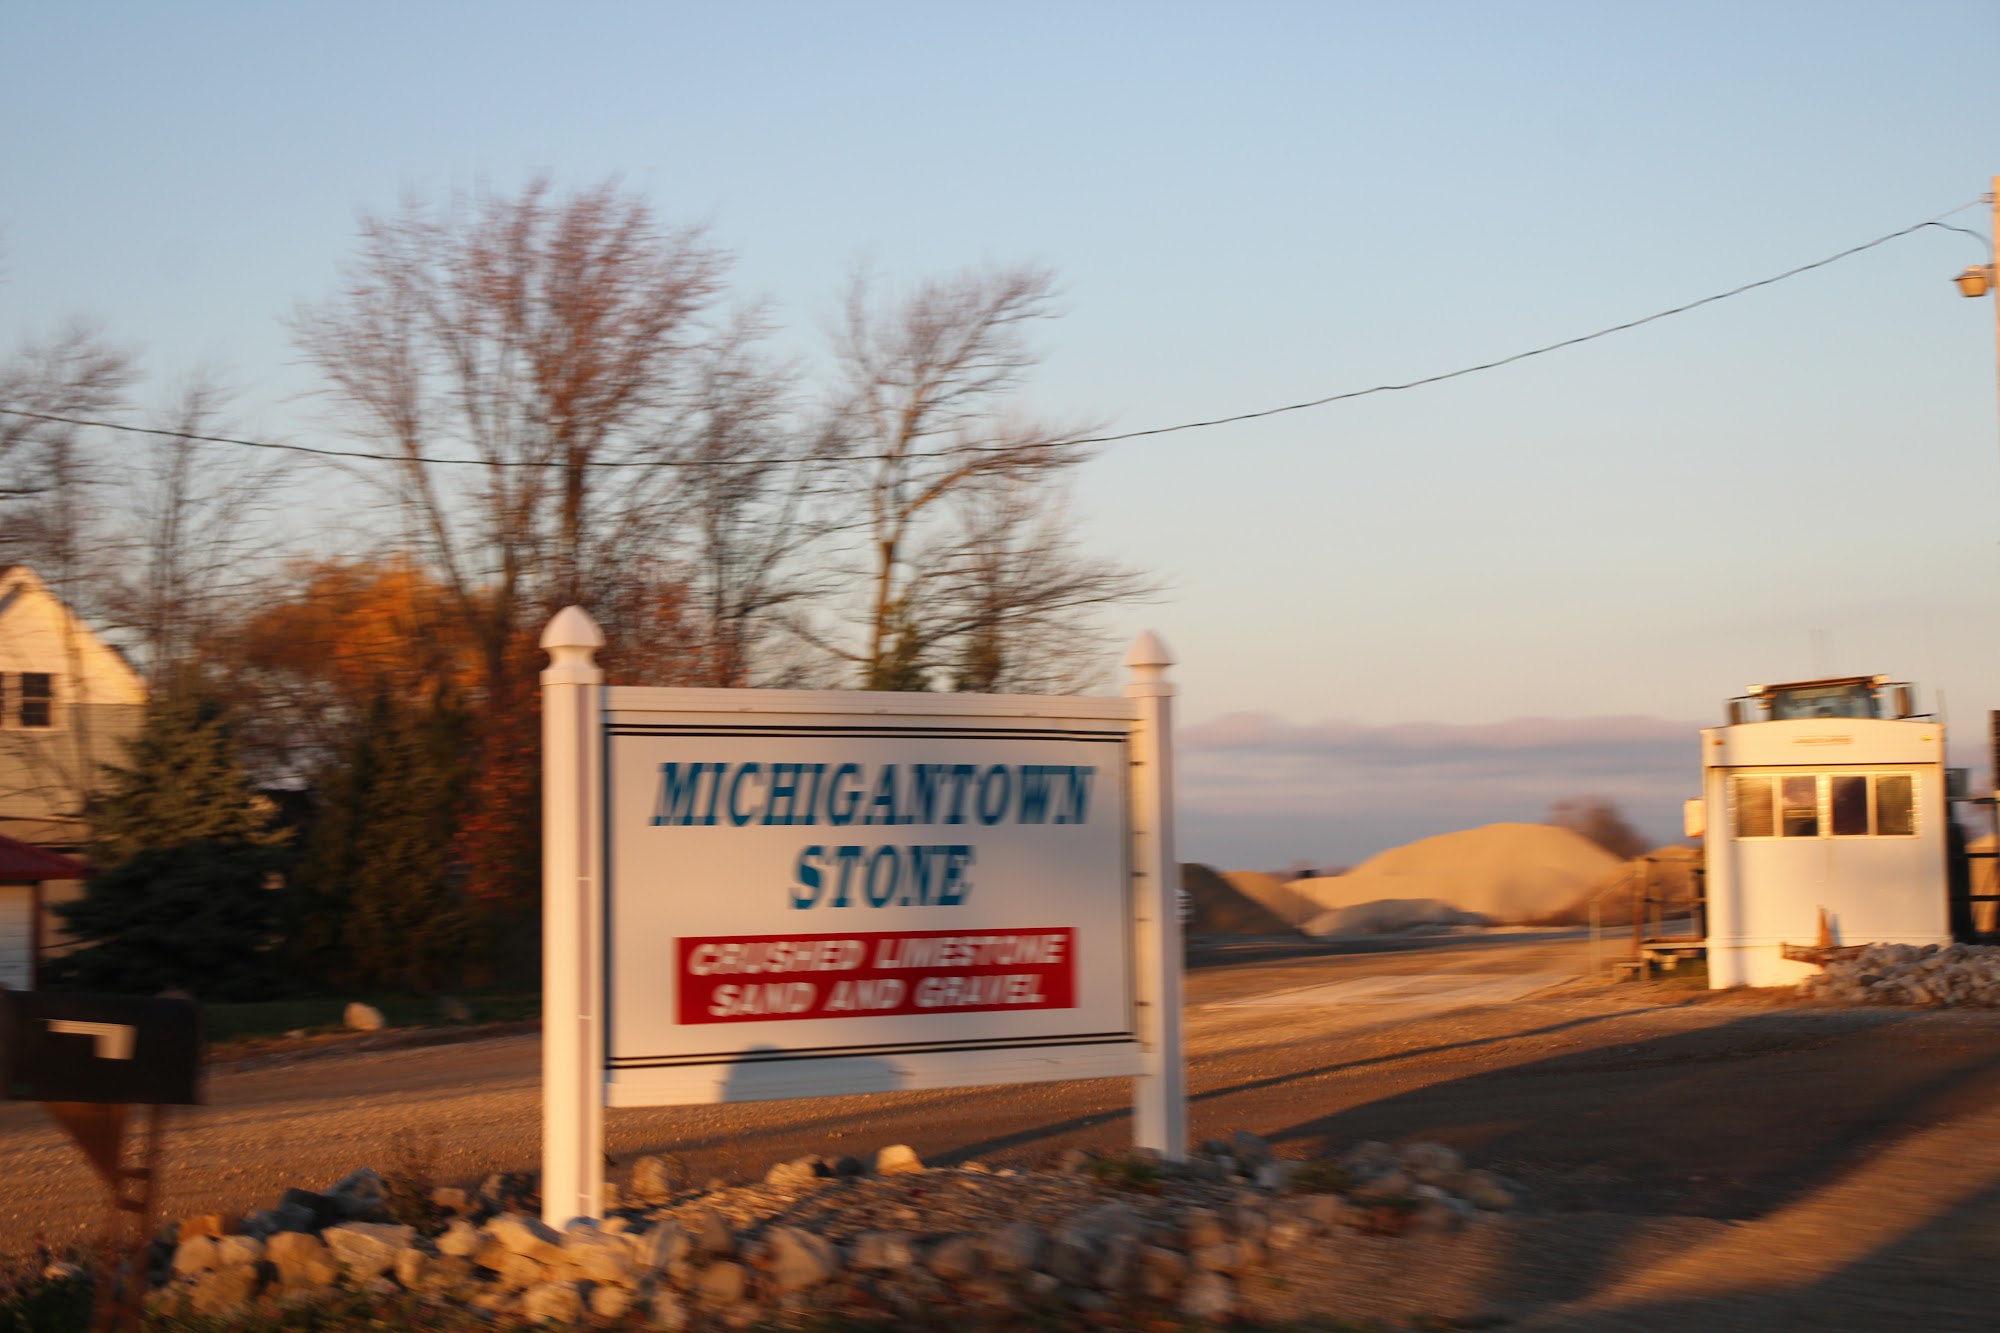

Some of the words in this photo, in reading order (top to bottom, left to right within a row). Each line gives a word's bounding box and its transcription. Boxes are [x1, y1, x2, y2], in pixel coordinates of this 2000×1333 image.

[649, 762, 1096, 827] MICHIGANTOWN
[789, 845, 976, 909] STONE
[689, 940, 867, 976] CRUSHED
[873, 935, 1066, 969] LIMESTONE
[709, 982, 816, 1017] SAND
[824, 979, 906, 1012] AND
[914, 974, 1046, 1008] GRAVEL
